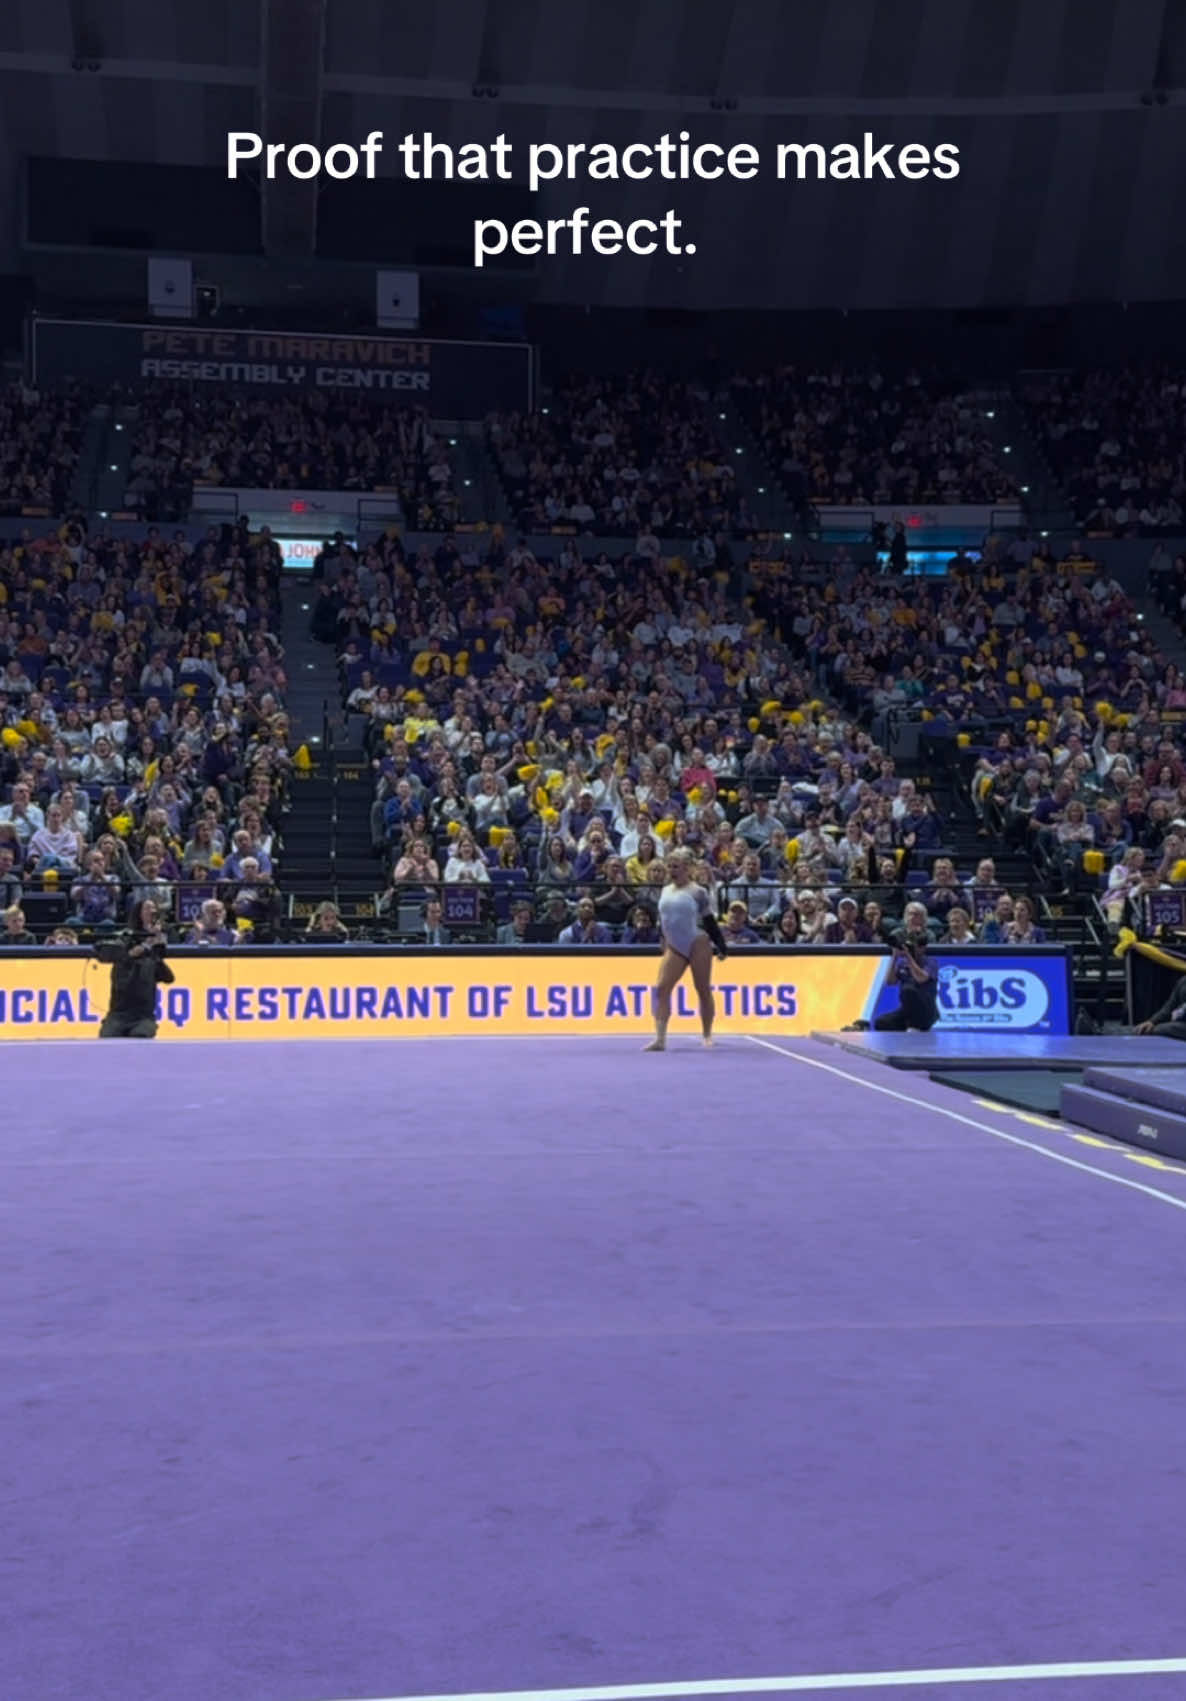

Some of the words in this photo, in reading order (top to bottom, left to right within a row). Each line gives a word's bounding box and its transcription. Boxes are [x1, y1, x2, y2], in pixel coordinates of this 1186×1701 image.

[142, 331, 236, 355] PETE
[247, 336, 431, 364] MARAVICH
[141, 359, 306, 384] ASSEMBLY
[315, 367, 431, 390] CENTER
[448, 904, 473, 918] 104
[206, 986, 453, 1020] RESTAURANT
[468, 986, 512, 1018] OF
[526, 985, 592, 1017] LSU
[605, 985, 797, 1016] ATLTICS
